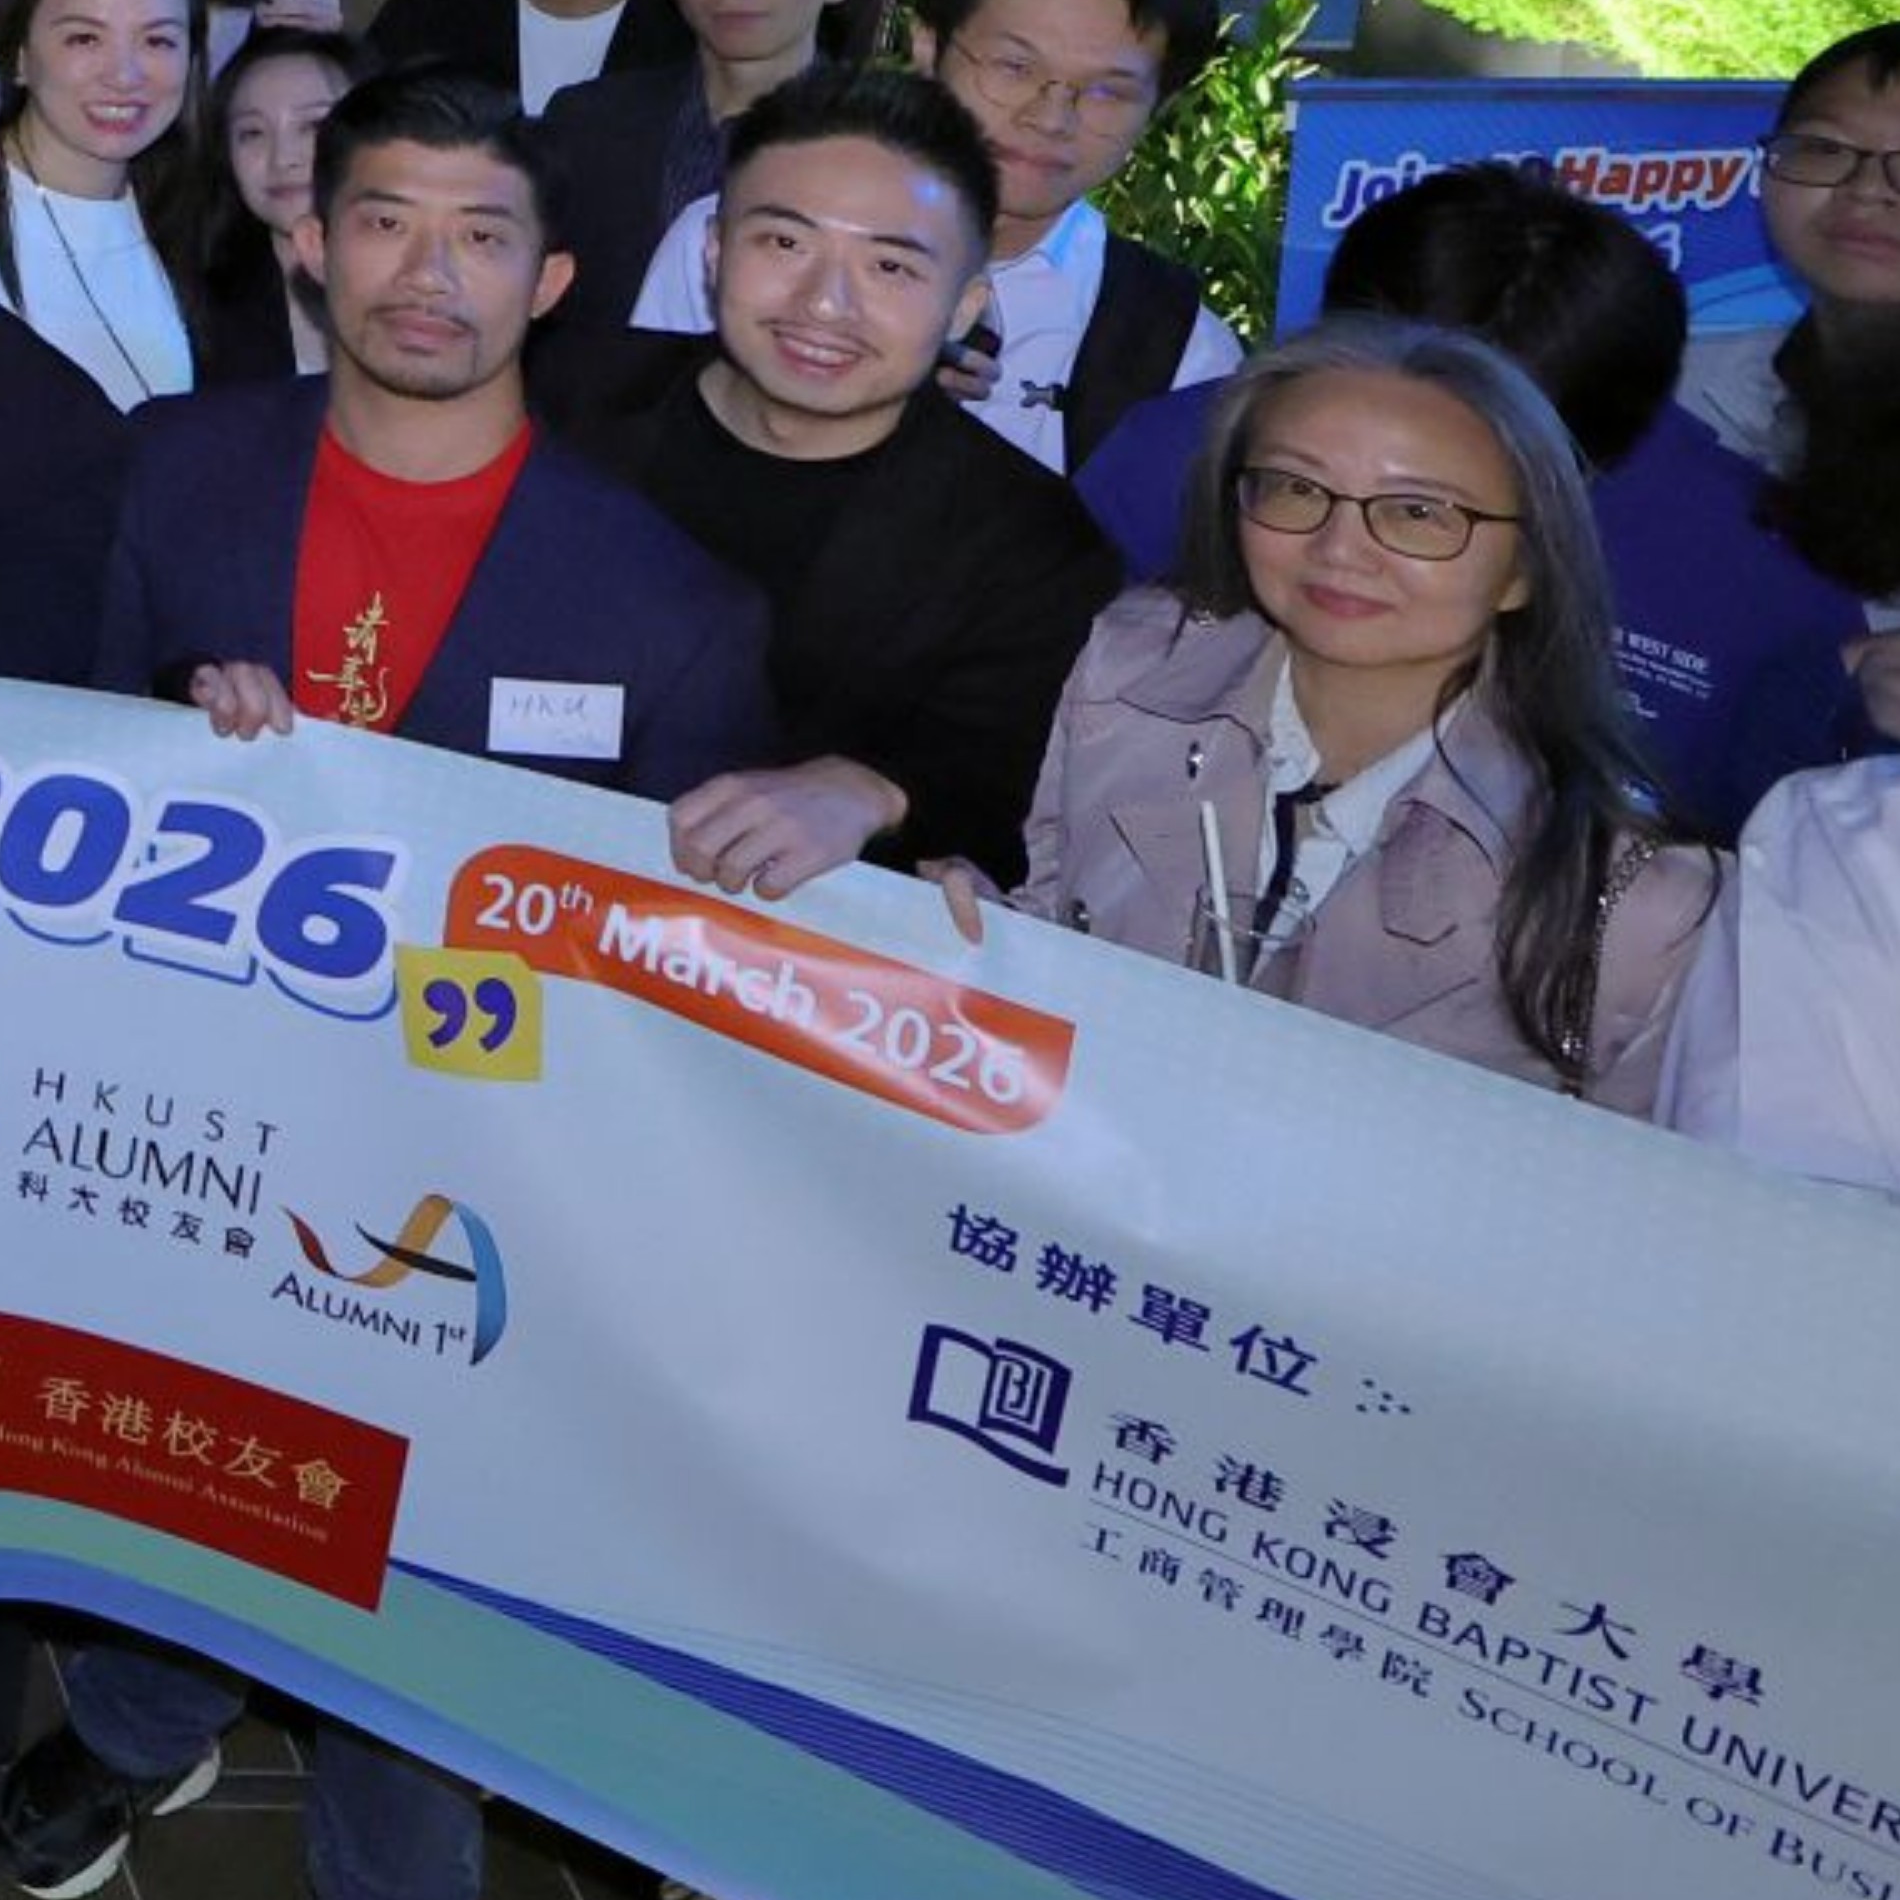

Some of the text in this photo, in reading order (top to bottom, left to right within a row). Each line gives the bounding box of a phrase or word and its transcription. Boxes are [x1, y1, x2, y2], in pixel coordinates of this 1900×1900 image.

[1559, 154, 1745, 202] Happy
[473, 872, 1030, 1108] 20th March 2026
[31, 1066, 279, 1156] HKUST
[16, 1170, 256, 1259] 科大校友會
[21, 1116, 263, 1215] ALUMNI
[271, 1271, 469, 1357] ALUMNI 1st
[36, 1375, 351, 1511] 香港校友會
[51, 1436, 109, 1471] Kong
[115, 1455, 194, 1492] Alumni
[202, 1484, 328, 1542] Association
[1092, 1459, 1229, 1543] HONG
[1249, 1528, 1393, 1616] KONG
[1415, 1600, 1661, 1727] BAPTIST
[1105, 1410, 1766, 1708] 香港浸會大學
[1079, 1522, 1434, 1702] 工商管理學院
[1460, 1686, 1669, 1806] SCHOOL
[1686, 1796, 1757, 1836] OF
